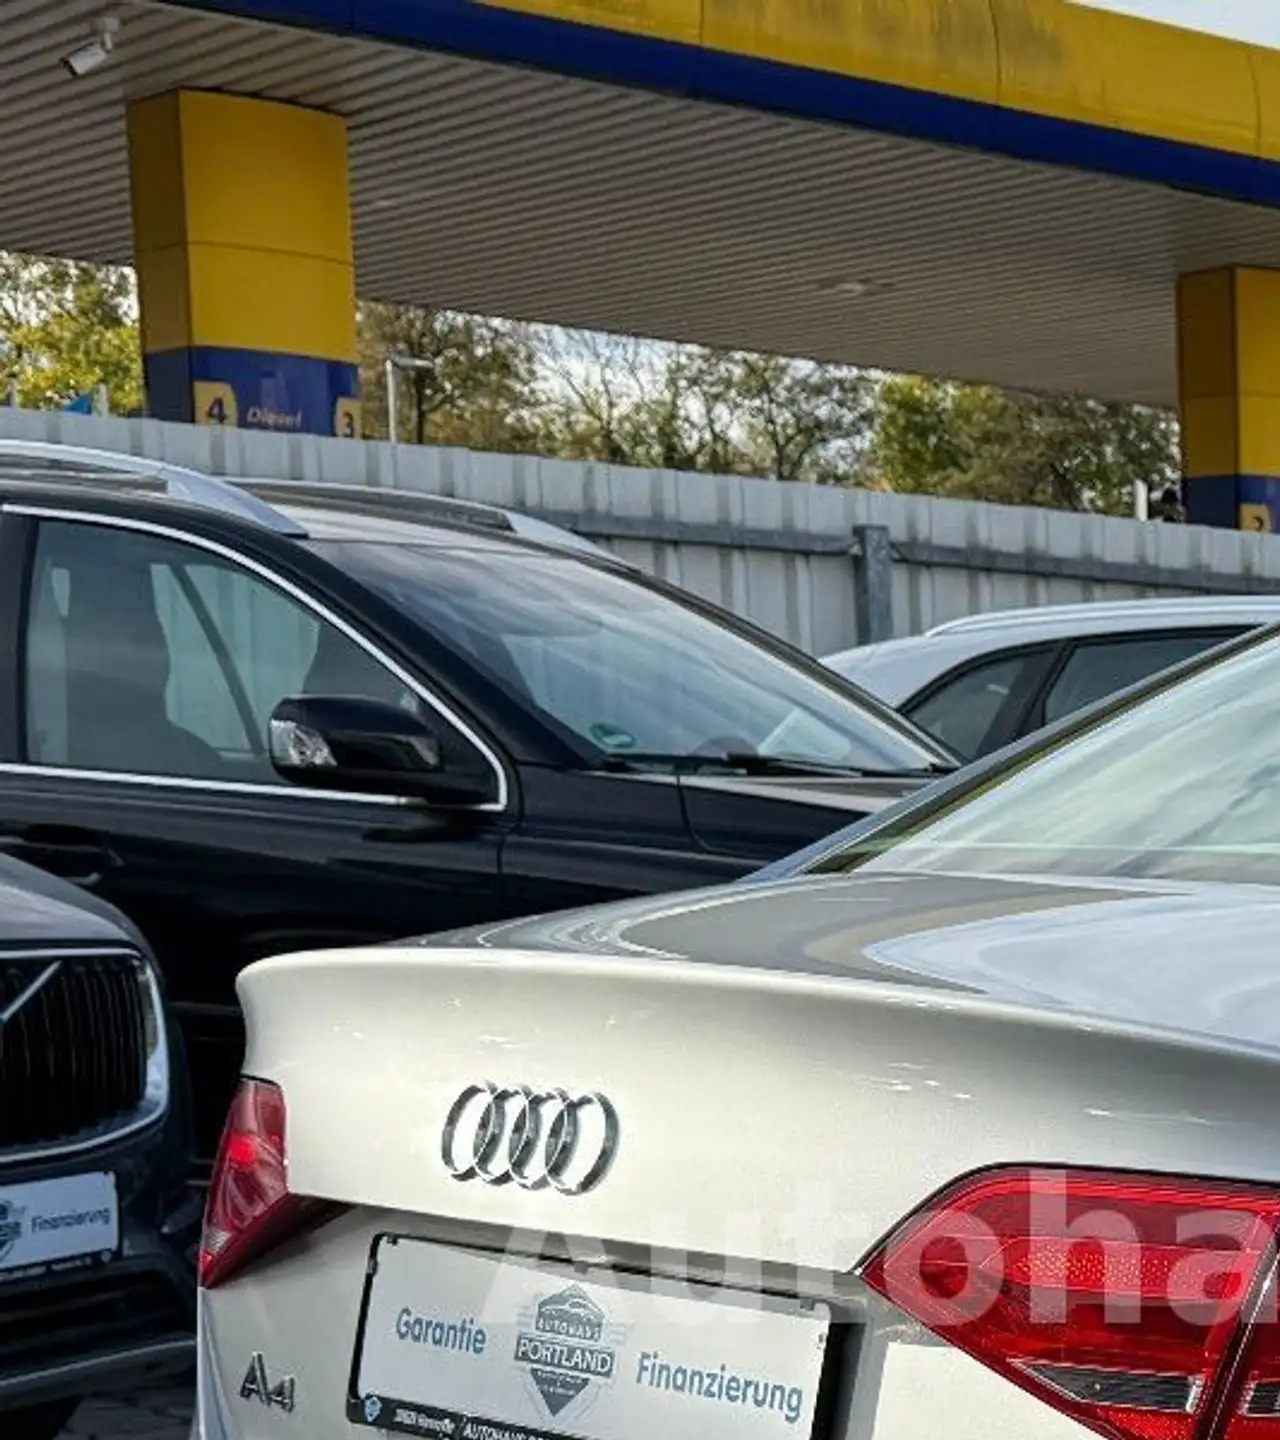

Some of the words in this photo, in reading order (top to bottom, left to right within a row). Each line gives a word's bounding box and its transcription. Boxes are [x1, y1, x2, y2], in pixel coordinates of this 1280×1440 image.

[247, 406, 302, 430] Diesel
[396, 1306, 486, 1355] Garantie
[518, 1339, 612, 1373] PORTLAND
[240, 1352, 296, 1415] A4
[636, 1351, 803, 1424] Finanzierung
